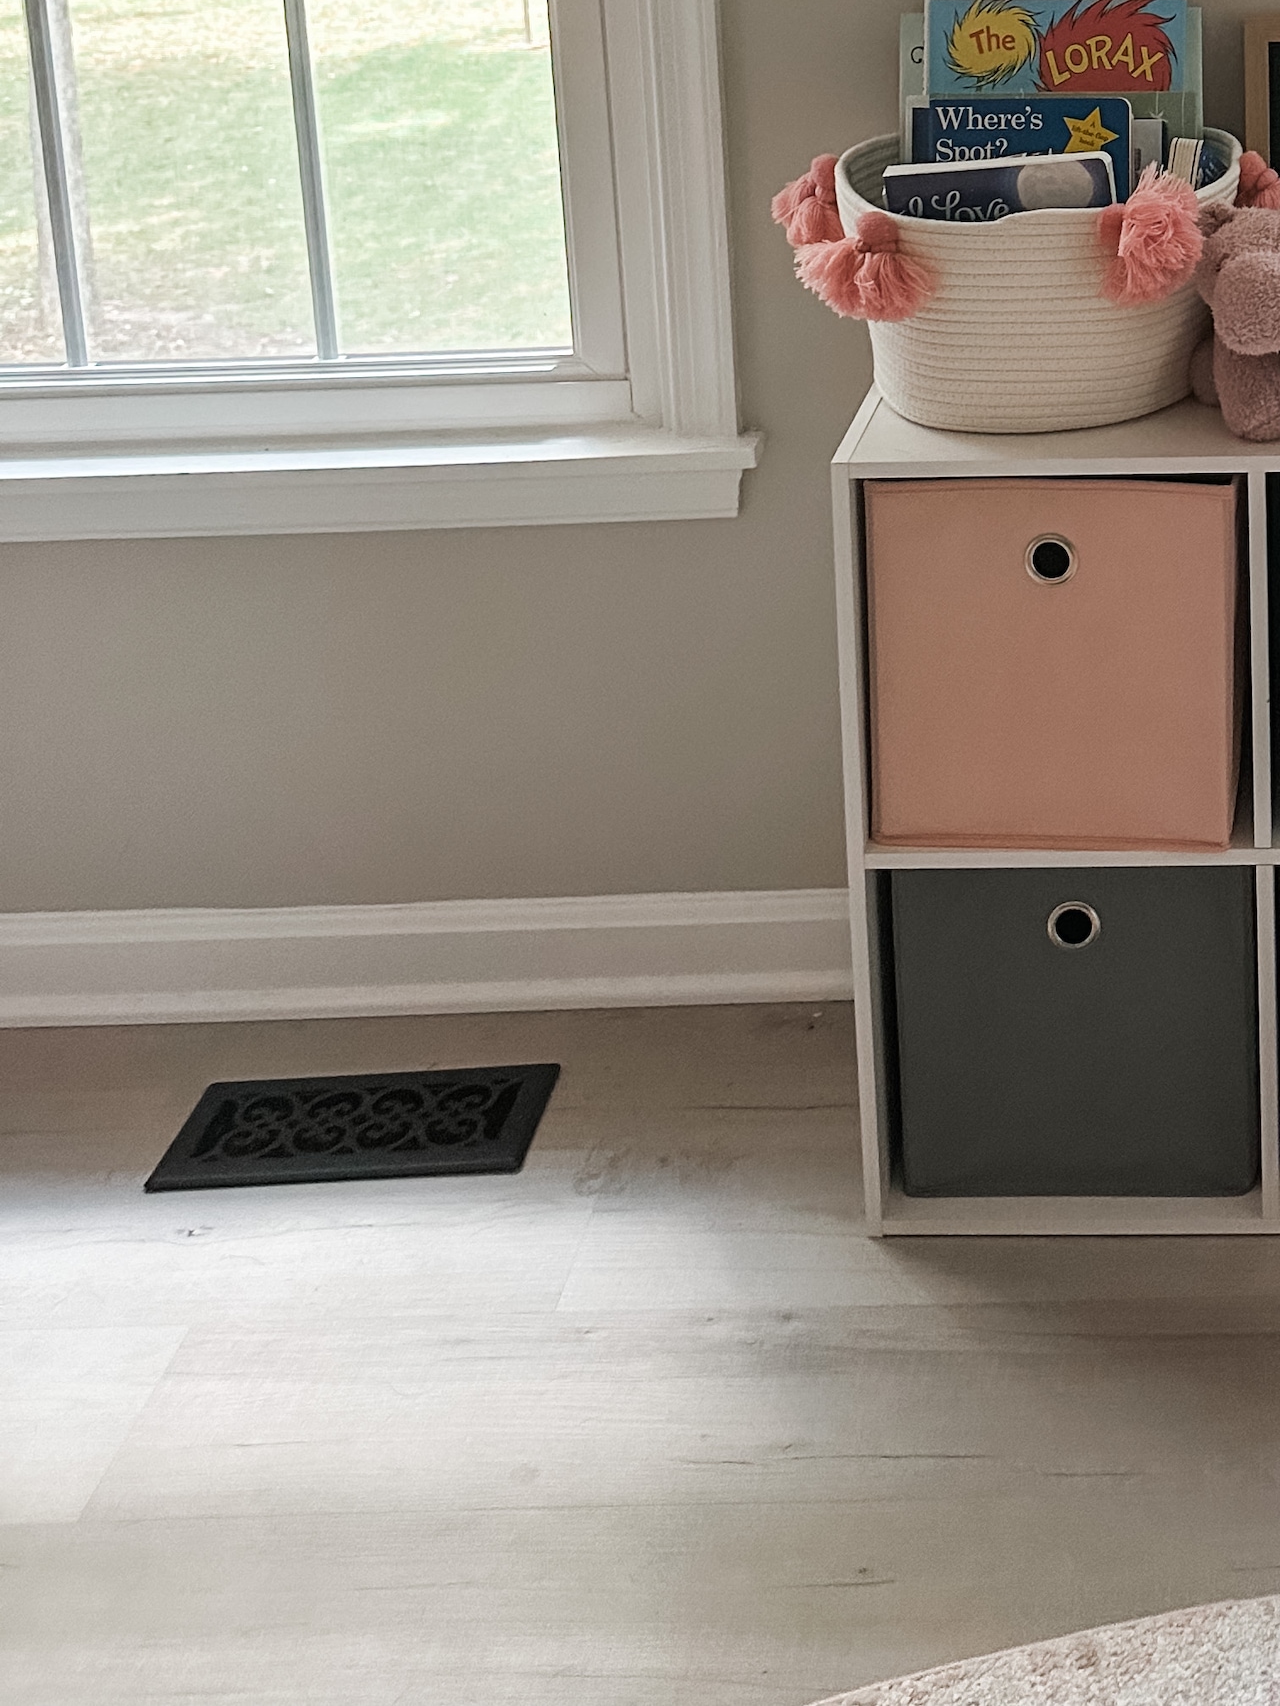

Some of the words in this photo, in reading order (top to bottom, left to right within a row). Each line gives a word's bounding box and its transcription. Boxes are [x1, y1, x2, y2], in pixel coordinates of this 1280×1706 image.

[969, 25, 1016, 55] The
[1045, 32, 1165, 86] LORAX
[935, 105, 1044, 130] Where's
[935, 138, 1009, 162] Spot?
